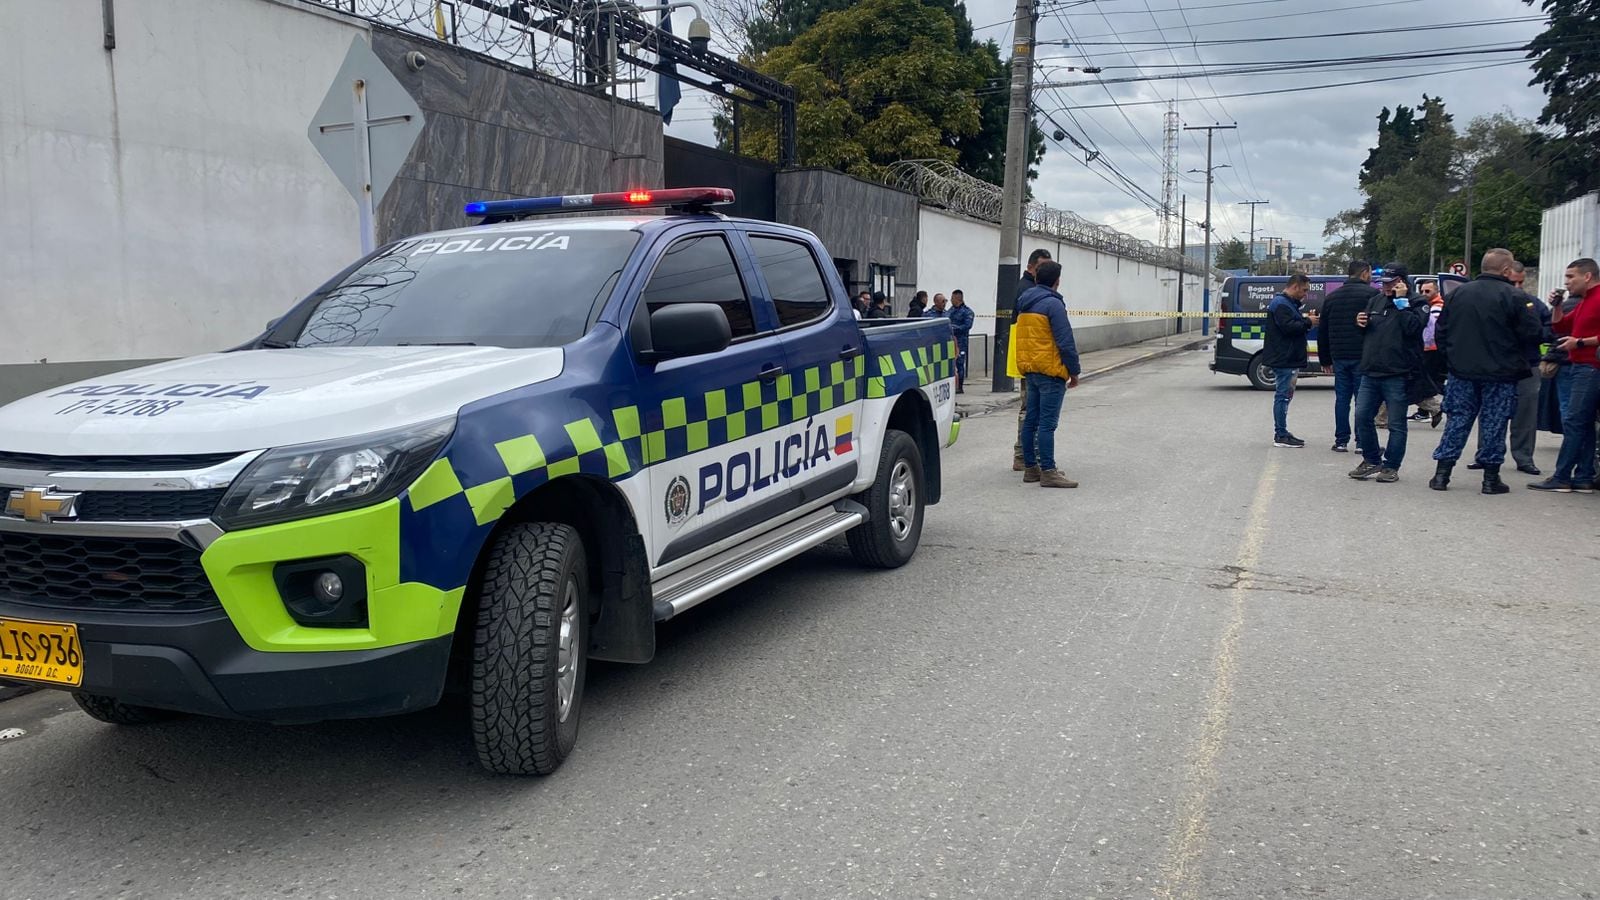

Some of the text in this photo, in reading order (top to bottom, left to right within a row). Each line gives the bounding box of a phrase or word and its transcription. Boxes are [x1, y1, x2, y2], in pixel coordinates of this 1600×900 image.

[410, 232, 570, 257] POLICÍA
[1247, 285, 1275, 293] Bogotá
[47, 381, 270, 400] POLICÍA
[54, 399, 185, 417] 17-1-2768
[697, 415, 831, 515] POLICÍA
[15, 663, 42, 676] BOGOTA
